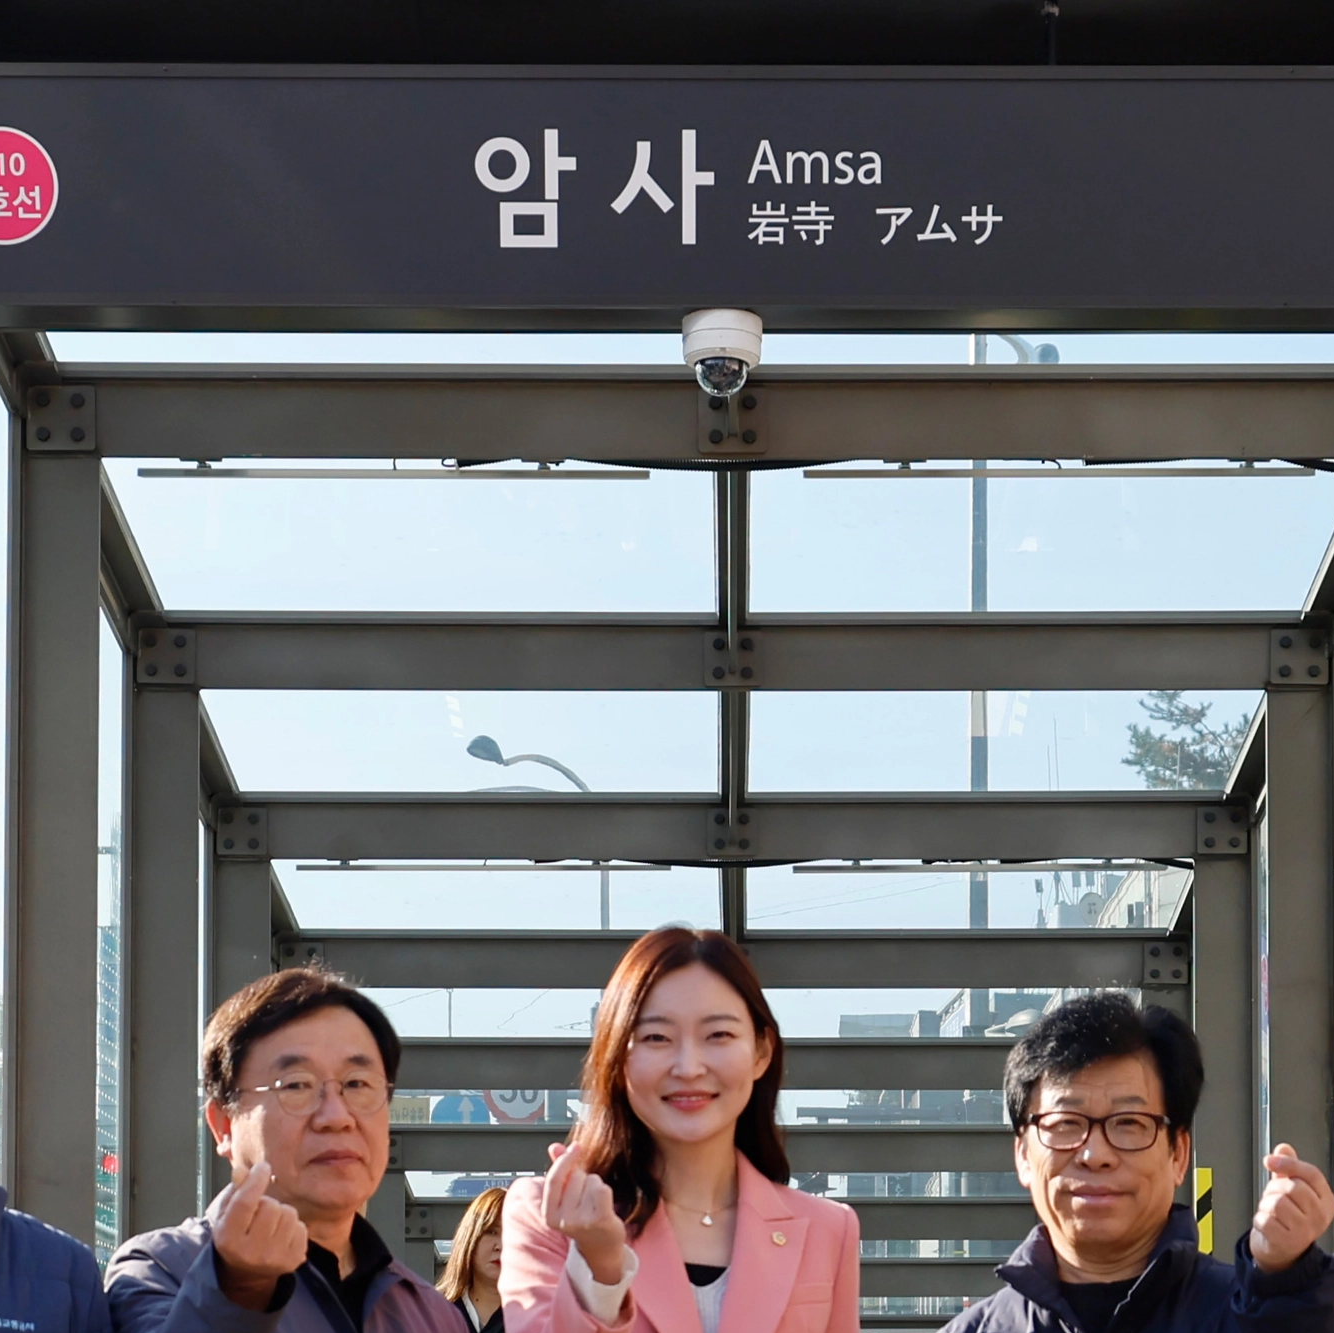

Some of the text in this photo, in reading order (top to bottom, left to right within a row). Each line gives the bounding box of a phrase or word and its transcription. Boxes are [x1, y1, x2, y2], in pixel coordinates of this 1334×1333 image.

[747, 139, 883, 185] Amsa
[474, 128, 715, 249] 암사
[747, 202, 1004, 246] 岩寺 アムサ
